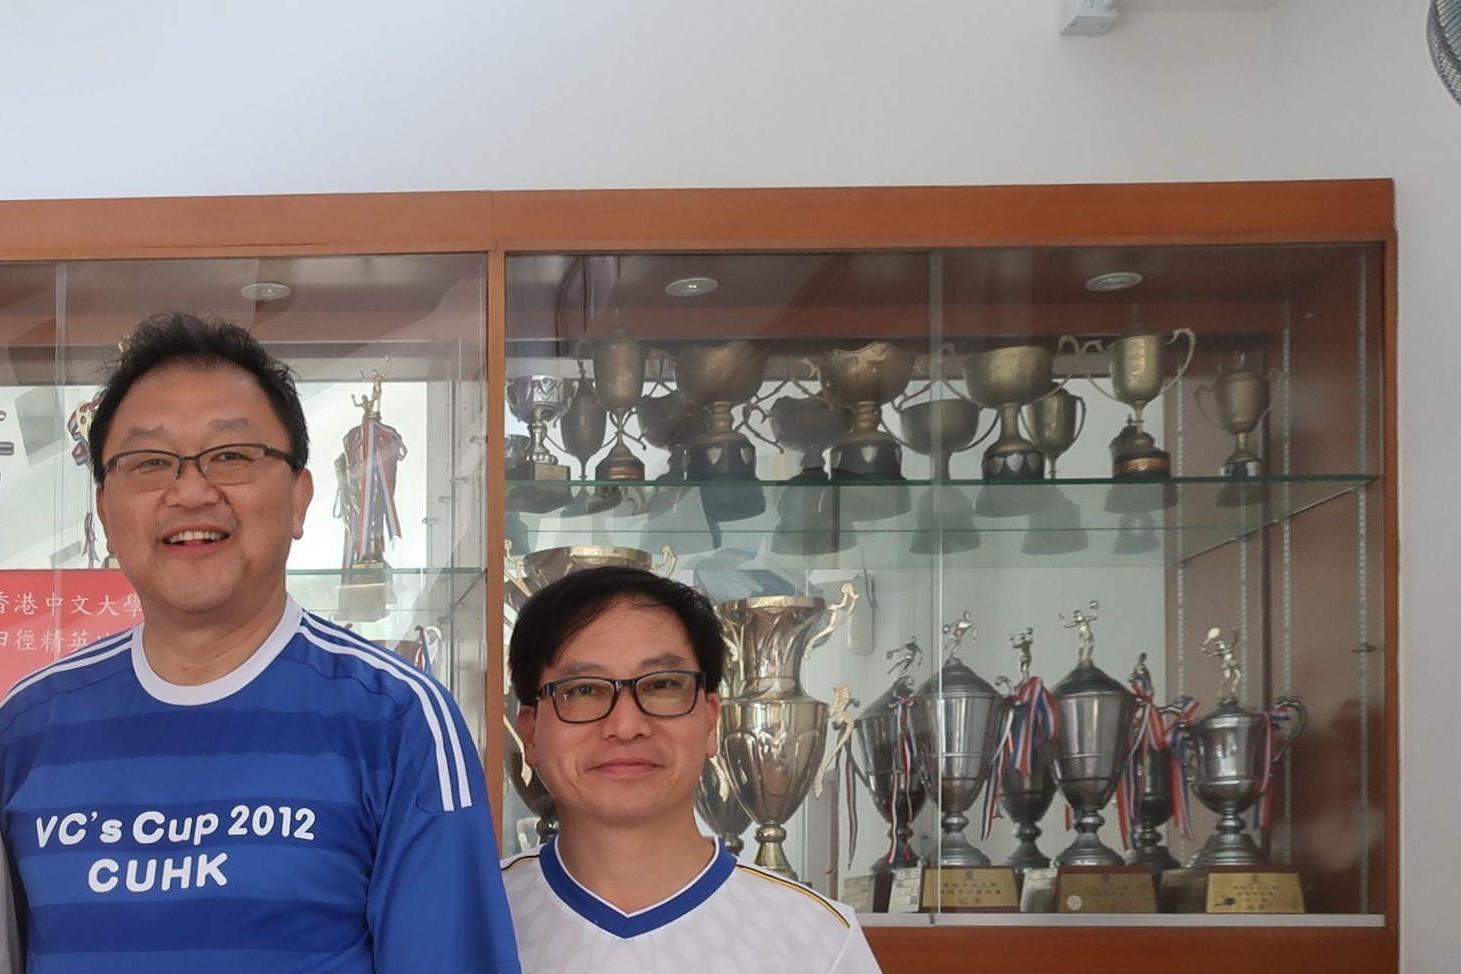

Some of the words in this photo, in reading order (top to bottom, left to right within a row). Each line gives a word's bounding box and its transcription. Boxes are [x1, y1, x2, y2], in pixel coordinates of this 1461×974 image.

[36, 811, 124, 848] VC's
[133, 811, 219, 846] Cup
[228, 805, 316, 841] 2012
[88, 853, 228, 893] CUHK
